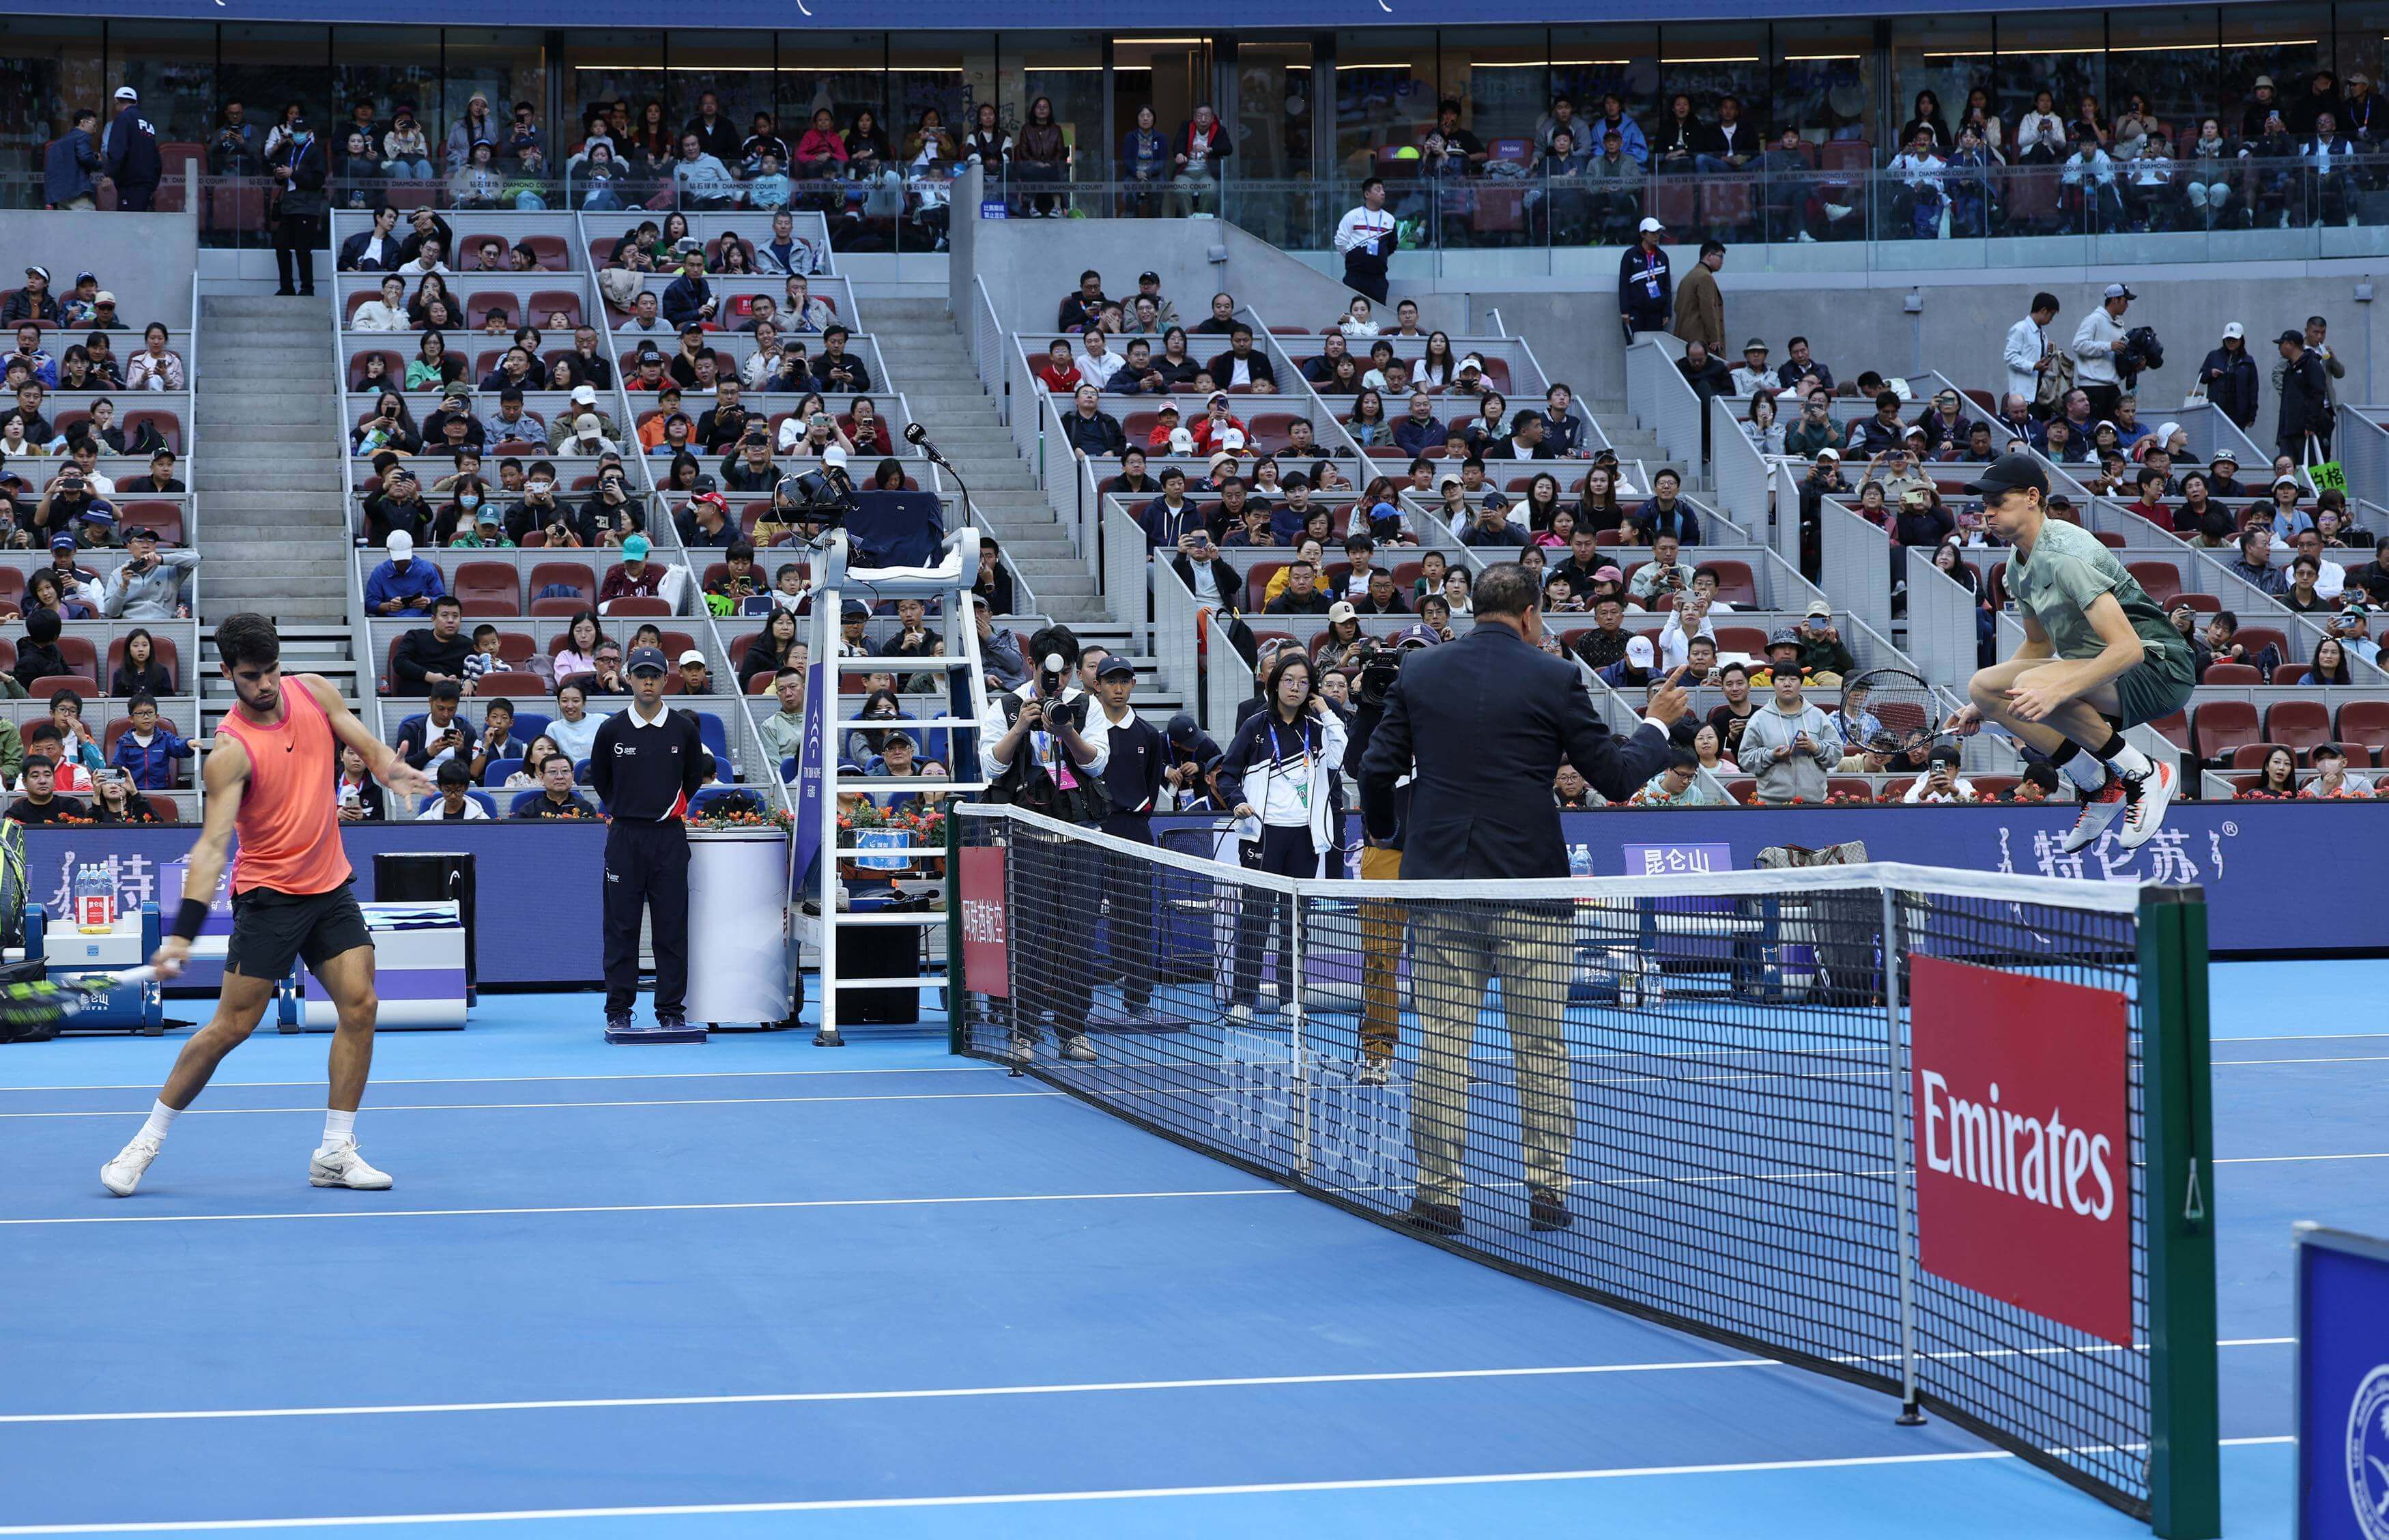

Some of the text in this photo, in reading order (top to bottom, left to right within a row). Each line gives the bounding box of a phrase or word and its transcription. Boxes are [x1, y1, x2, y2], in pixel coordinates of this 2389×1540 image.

[1644, 848, 1710, 876] 昆仑山
[962, 898, 1004, 944] 阿联酋航空
[1921, 1068, 2114, 1221] Emirates
